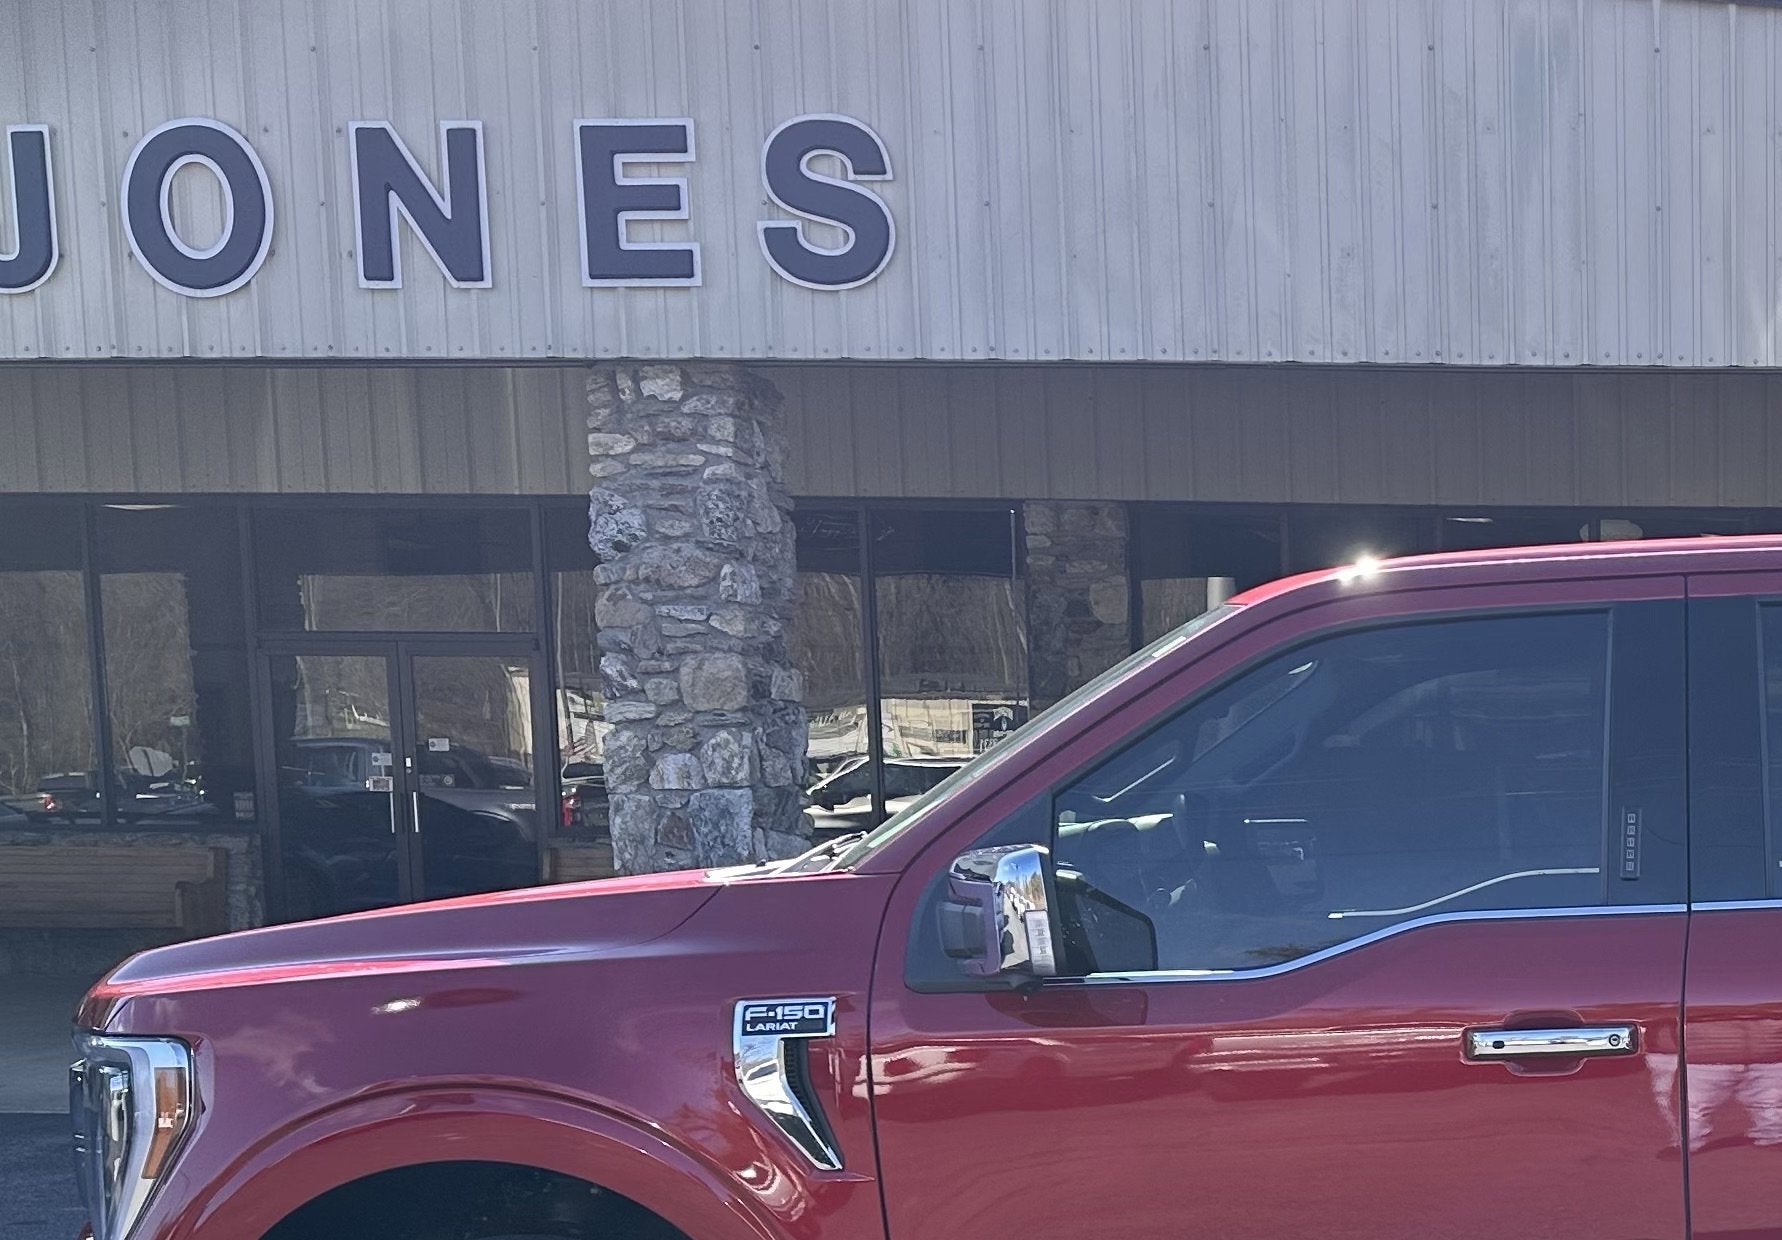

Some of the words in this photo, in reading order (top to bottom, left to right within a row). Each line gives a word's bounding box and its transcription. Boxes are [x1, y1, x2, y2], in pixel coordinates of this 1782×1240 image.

[0, 115, 897, 298] JONES
[745, 1004, 825, 1021] F-150
[746, 1021, 798, 1032] LARIAT
